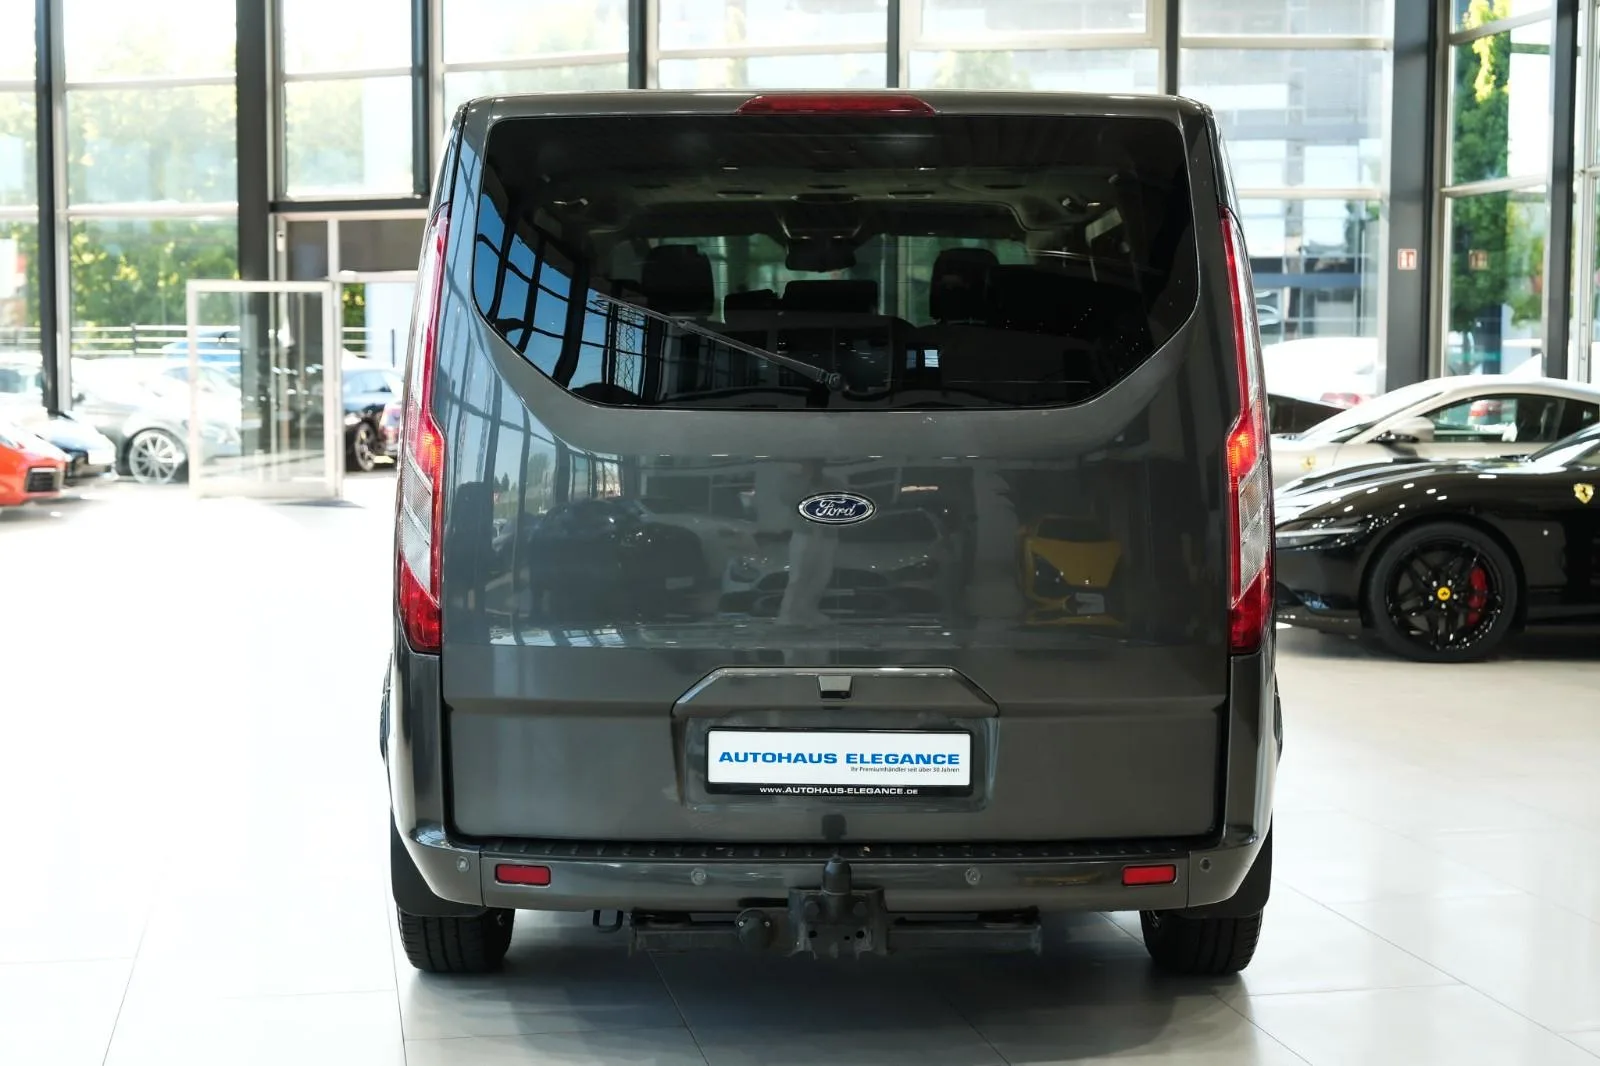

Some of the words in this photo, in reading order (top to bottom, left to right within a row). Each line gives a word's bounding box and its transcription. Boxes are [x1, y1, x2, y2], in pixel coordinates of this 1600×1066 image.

[816, 498, 864, 516] Ford
[718, 751, 838, 764] AUTOHAUS
[845, 753, 960, 765] ELEGANCE
